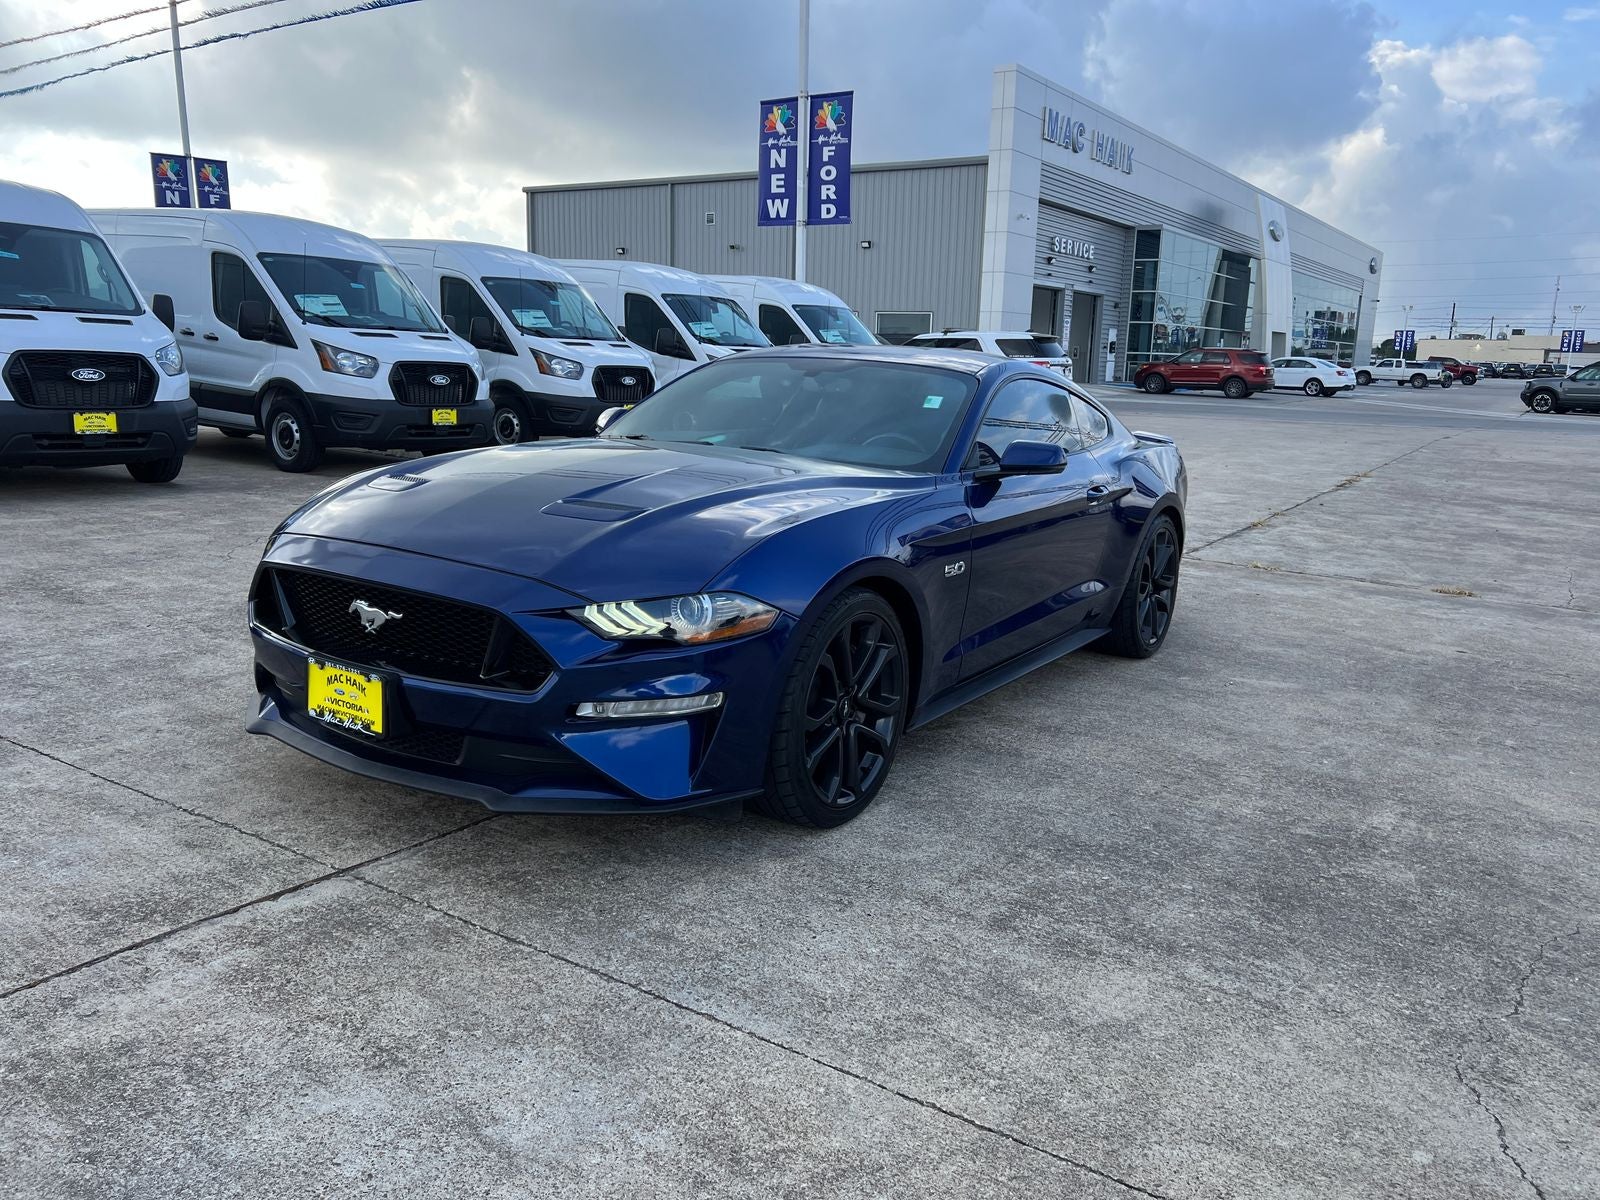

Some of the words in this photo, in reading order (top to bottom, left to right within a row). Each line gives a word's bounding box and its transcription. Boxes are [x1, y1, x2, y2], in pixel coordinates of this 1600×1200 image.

[1042, 106, 1086, 154] MAC
[1091, 129, 1135, 175] HAIK
[766, 148, 789, 219] NEW
[820, 146, 837, 219] FORD
[1053, 236, 1095, 260] SERVICE
[78, 370, 100, 379] Ford
[326, 673, 344, 687] MAC
[345, 675, 367, 697] HAIK
[330, 696, 364, 714] VICTORIA
[322, 711, 343, 726] Mac
[343, 717, 365, 731] Haik
